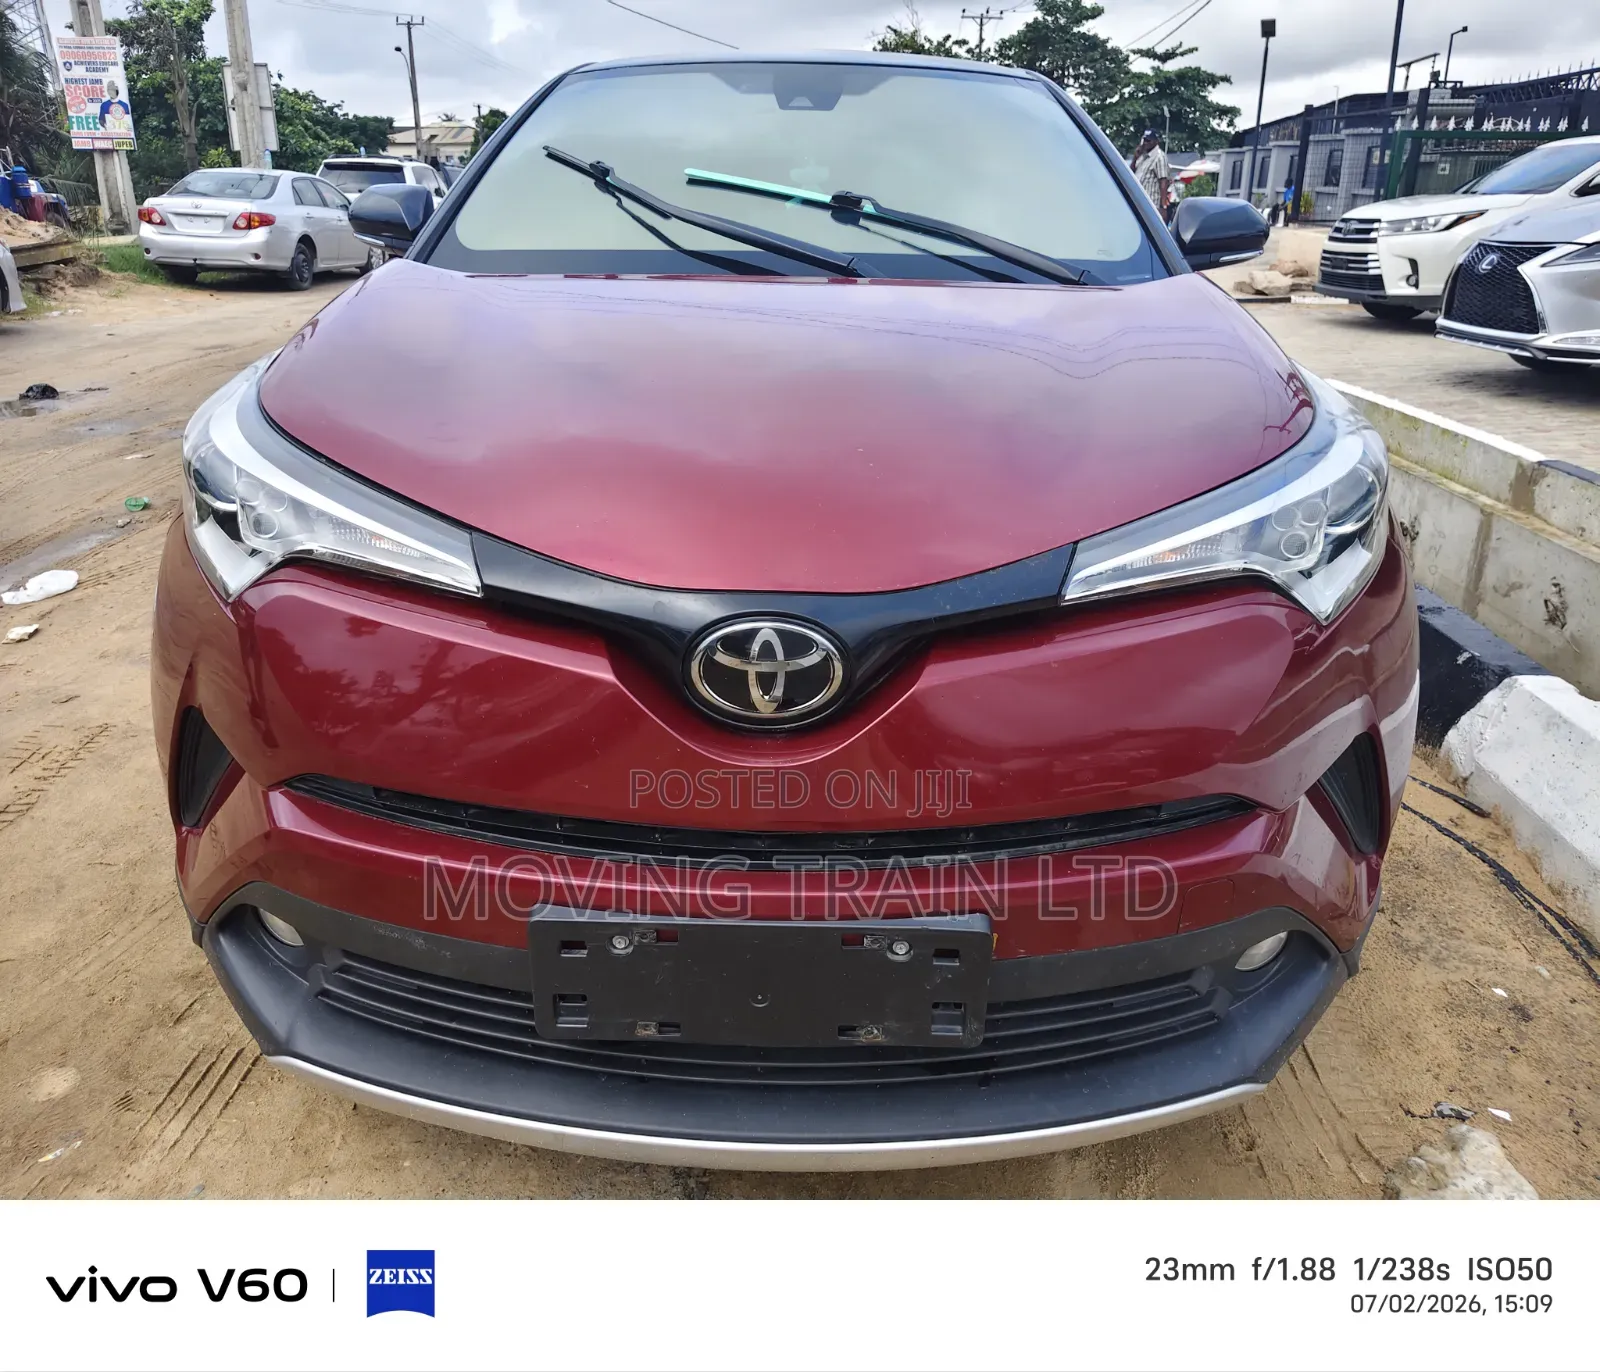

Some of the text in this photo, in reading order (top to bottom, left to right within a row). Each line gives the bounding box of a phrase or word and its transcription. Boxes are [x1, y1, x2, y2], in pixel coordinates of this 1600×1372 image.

[60, 50, 117, 60] 09060956823
[65, 85, 106, 98] SCORE
[68, 116, 100, 130] FREE
